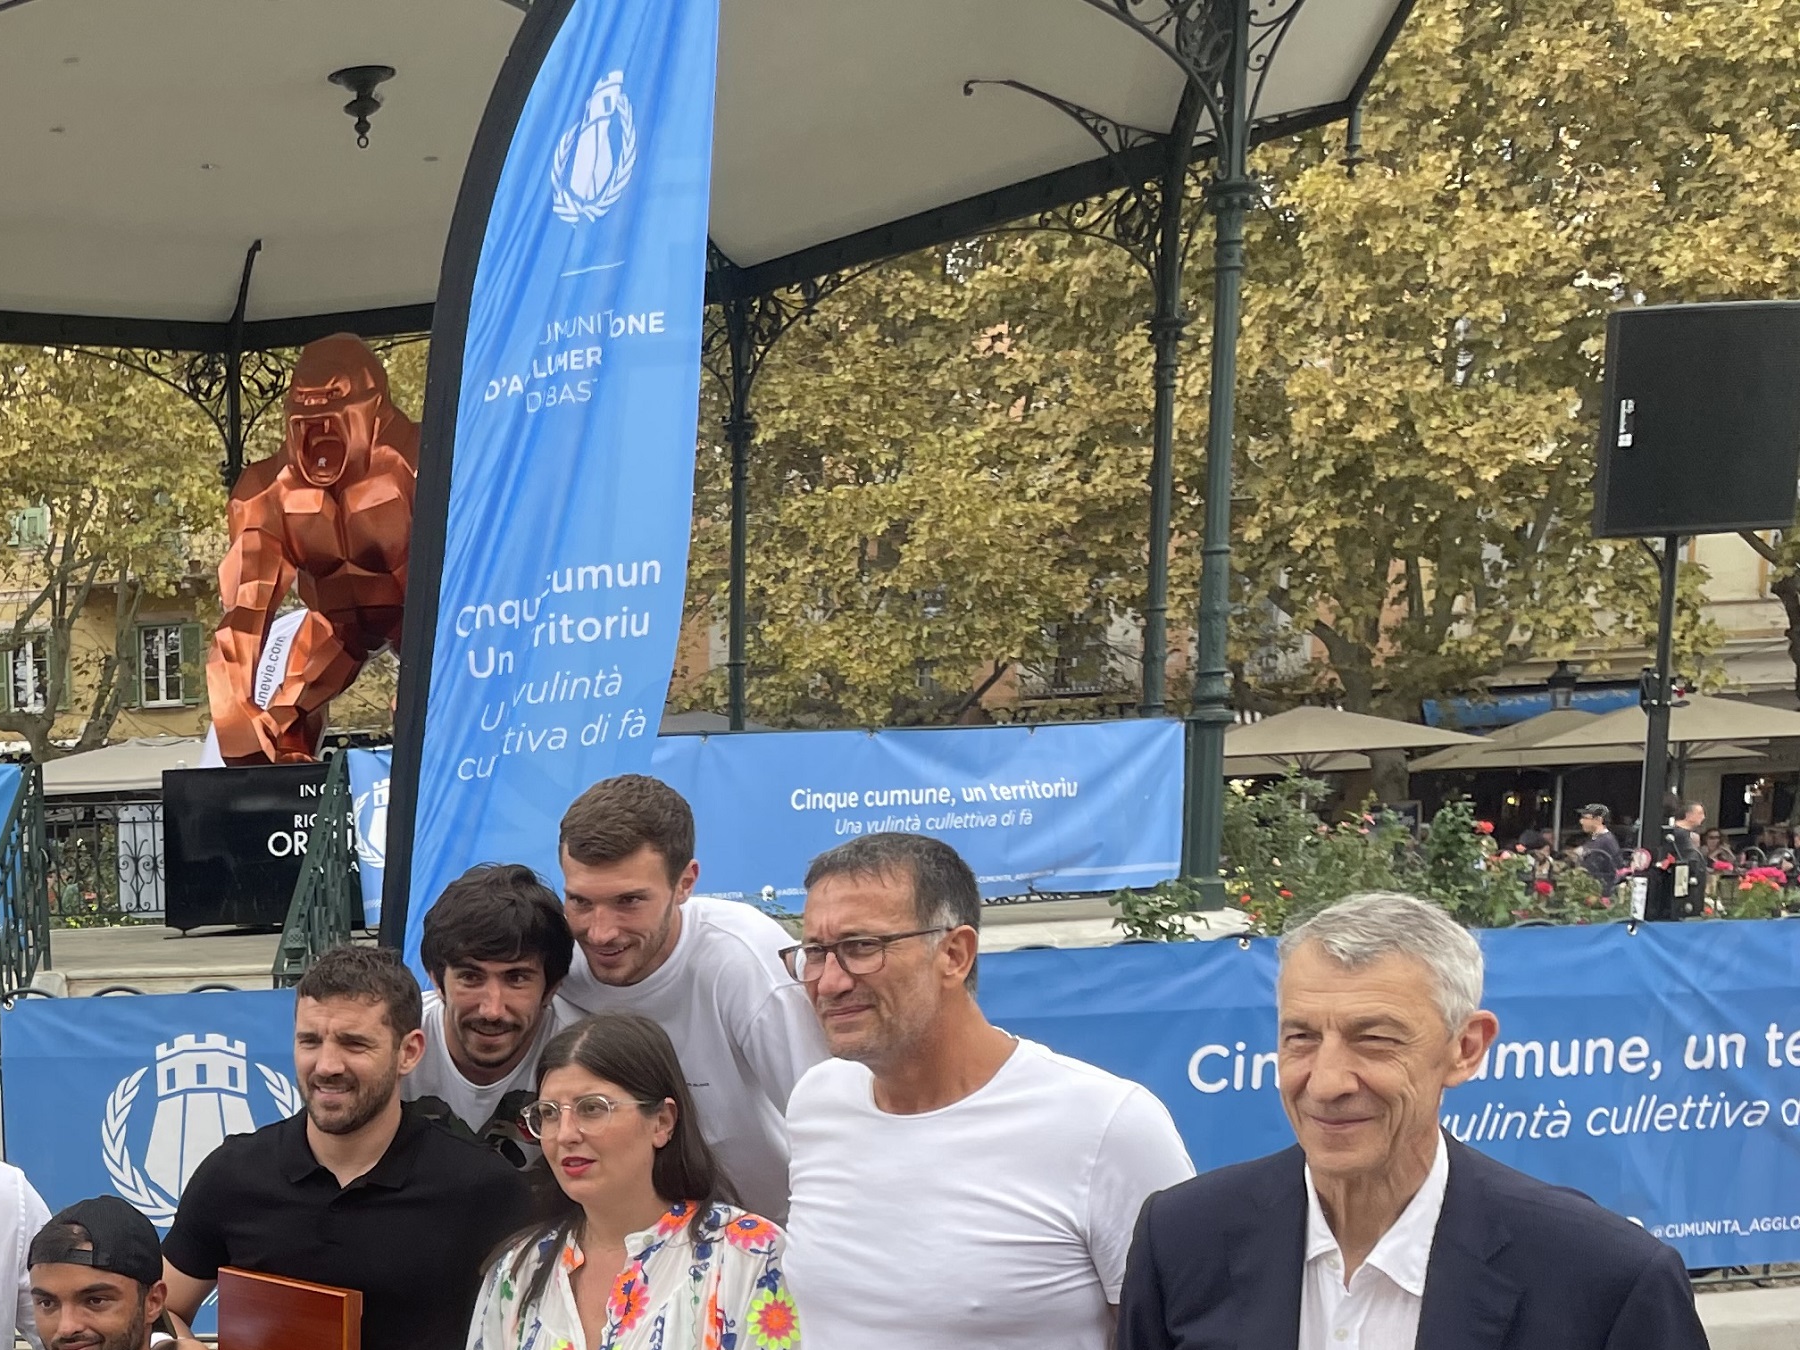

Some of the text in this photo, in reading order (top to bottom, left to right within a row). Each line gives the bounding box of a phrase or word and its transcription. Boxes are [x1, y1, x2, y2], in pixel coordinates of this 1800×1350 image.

[467, 645, 515, 679] Un
[580, 713, 612, 747] di
[618, 708, 647, 741] fà
[790, 777, 1079, 814] Cinque cumune, un territoriu
[834, 808, 1034, 836] Una vulintà cullettiva di fà
[1683, 1031, 1747, 1070] un
[1585, 1091, 1770, 1138] cullettiva
